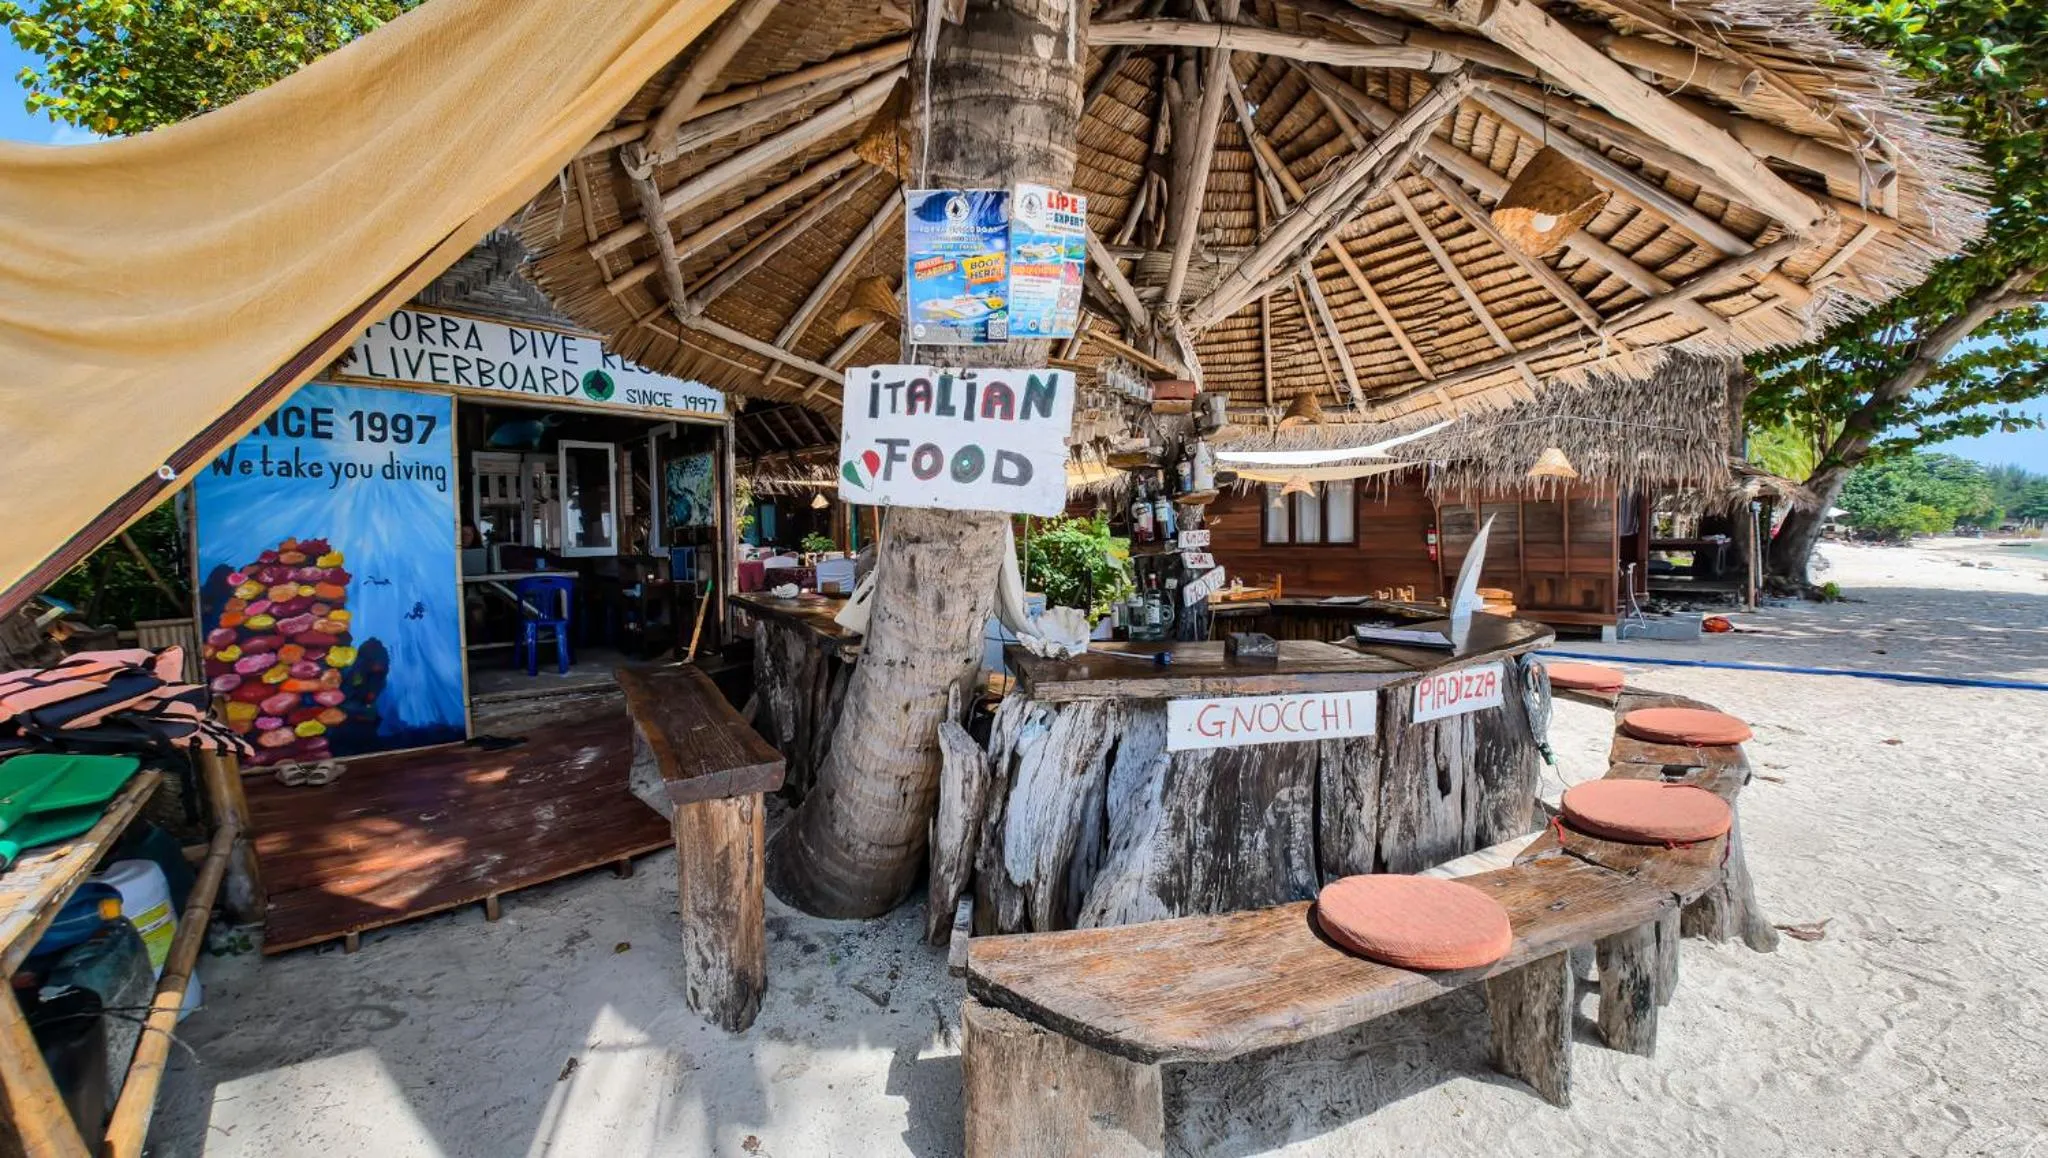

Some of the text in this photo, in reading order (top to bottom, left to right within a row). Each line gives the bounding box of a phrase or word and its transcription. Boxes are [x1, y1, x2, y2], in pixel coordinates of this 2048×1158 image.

[1047, 191, 1078, 214] LIPE
[1054, 212, 1085, 227] EXPERT
[970, 257, 1001, 269] BOOK
[509, 327, 579, 365] DIVE
[363, 343, 580, 396] LIVERBOARD
[625, 388, 717, 413] SINCE 1997
[251, 406, 437, 445] NCE 1997
[211, 442, 447, 492] We take you diving
[874, 438, 1034, 487] FOOD
[1418, 669, 1497, 713] PIADIZZA
[1196, 698, 1354, 738] GNOCCHI
